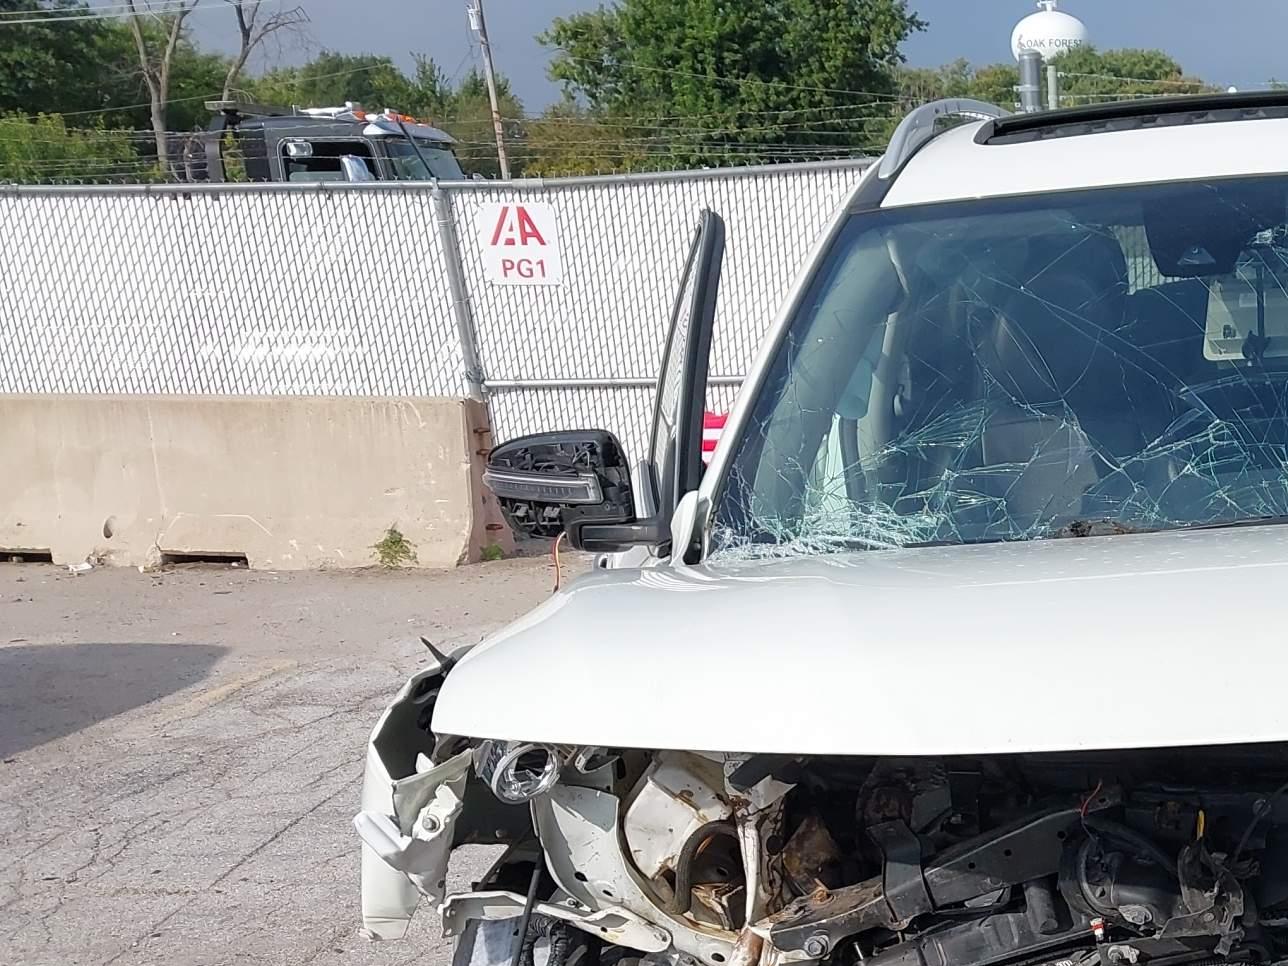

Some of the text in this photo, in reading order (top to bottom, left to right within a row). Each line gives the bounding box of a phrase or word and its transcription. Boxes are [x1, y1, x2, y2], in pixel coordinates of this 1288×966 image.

[1026, 38, 1082, 48] OAK FOREST
[502, 258, 545, 278] PG1
